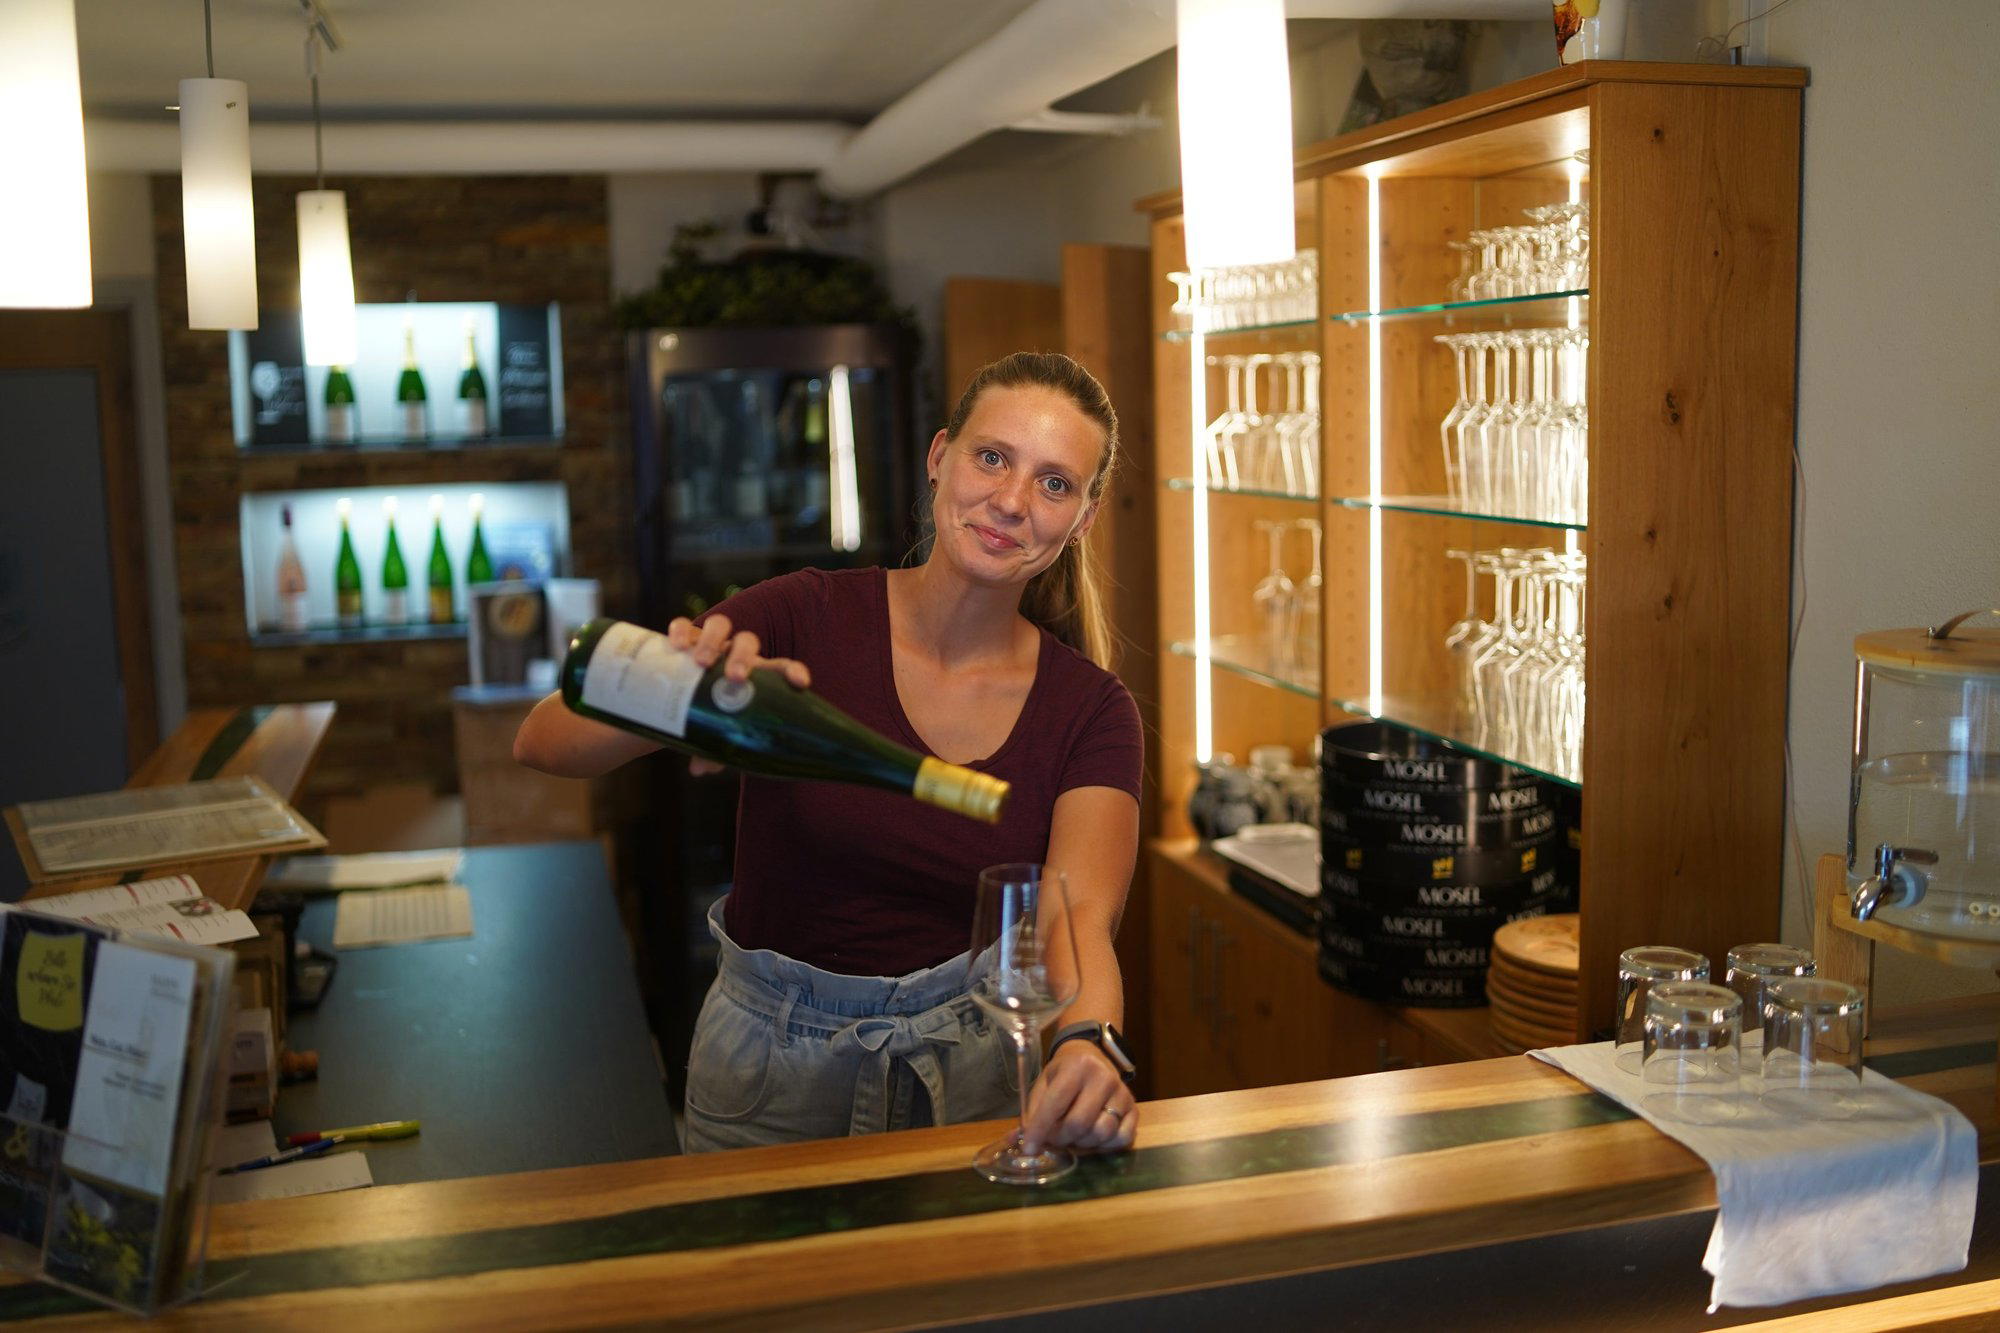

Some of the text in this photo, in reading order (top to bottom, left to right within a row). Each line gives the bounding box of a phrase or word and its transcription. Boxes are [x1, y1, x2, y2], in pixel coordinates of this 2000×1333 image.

[1383, 760, 1448, 782] MOSEL
[1364, 789, 1423, 813] MOSEL
[1401, 824, 1465, 844] MOSEL
[1417, 886, 1481, 906] MOSEL
[1382, 915, 1445, 938] MOSEL
[1424, 948, 1488, 968] MOSEL
